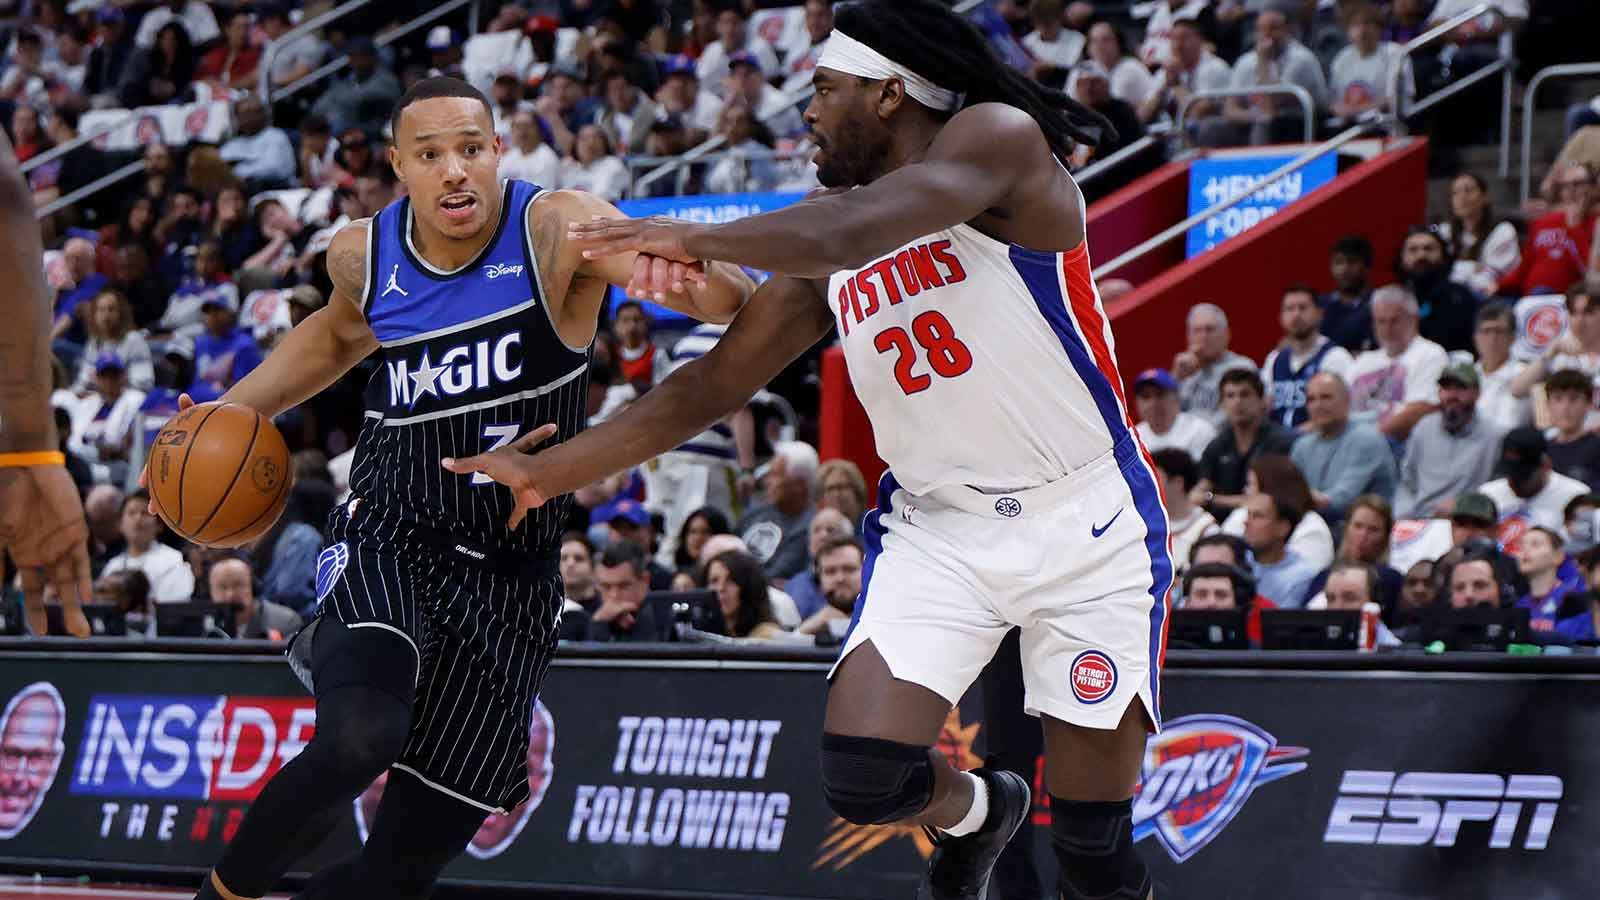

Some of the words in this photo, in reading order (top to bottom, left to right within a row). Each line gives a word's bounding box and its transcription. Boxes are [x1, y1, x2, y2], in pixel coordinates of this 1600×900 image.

[483, 263, 524, 279] Disney
[837, 239, 967, 337] PISTONS
[873, 309, 974, 396] 28
[1076, 675, 1106, 689] PISTONS
[1077, 666, 1108, 680] DETROIT
[612, 716, 782, 779] TONIGHT
[1132, 744, 1242, 826] OKC
[1322, 770, 1564, 850] ESPN
[100, 803, 179, 841] THE
[566, 784, 792, 852] FOLLOWING
